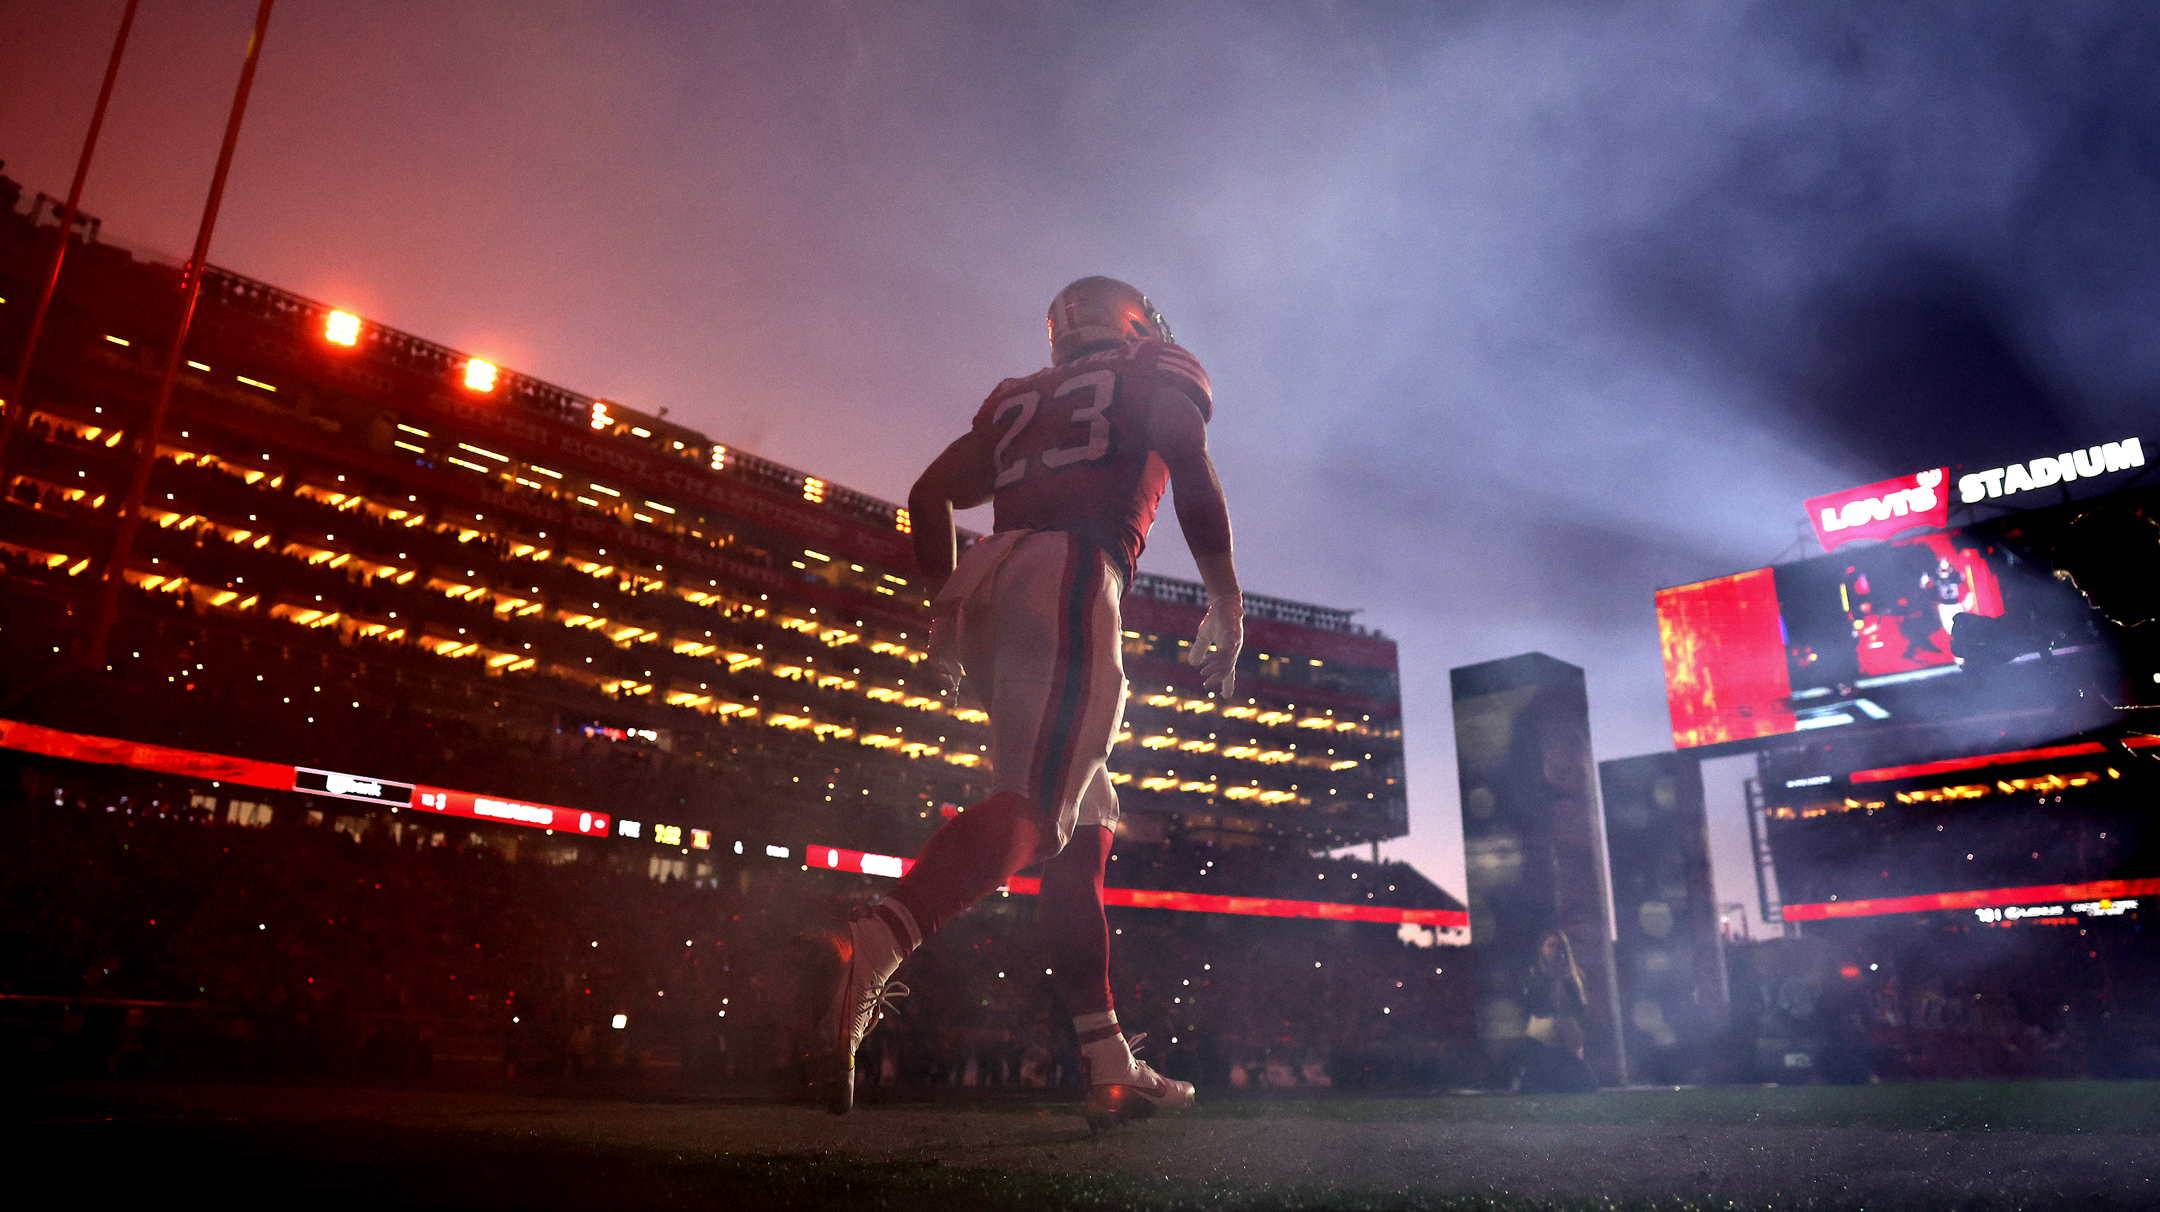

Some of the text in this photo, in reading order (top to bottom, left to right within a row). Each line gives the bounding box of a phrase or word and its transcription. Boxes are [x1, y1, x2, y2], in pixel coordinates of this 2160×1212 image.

[426, 393, 552, 444] SUPER
[558, 436, 659, 480] BOWL
[661, 471, 842, 537] CHAMPIONS
[992, 369, 1116, 489] 23
[1958, 437, 2145, 504] STADIUM
[478, 489, 791, 587] HOME OF THE FAITHFUL
